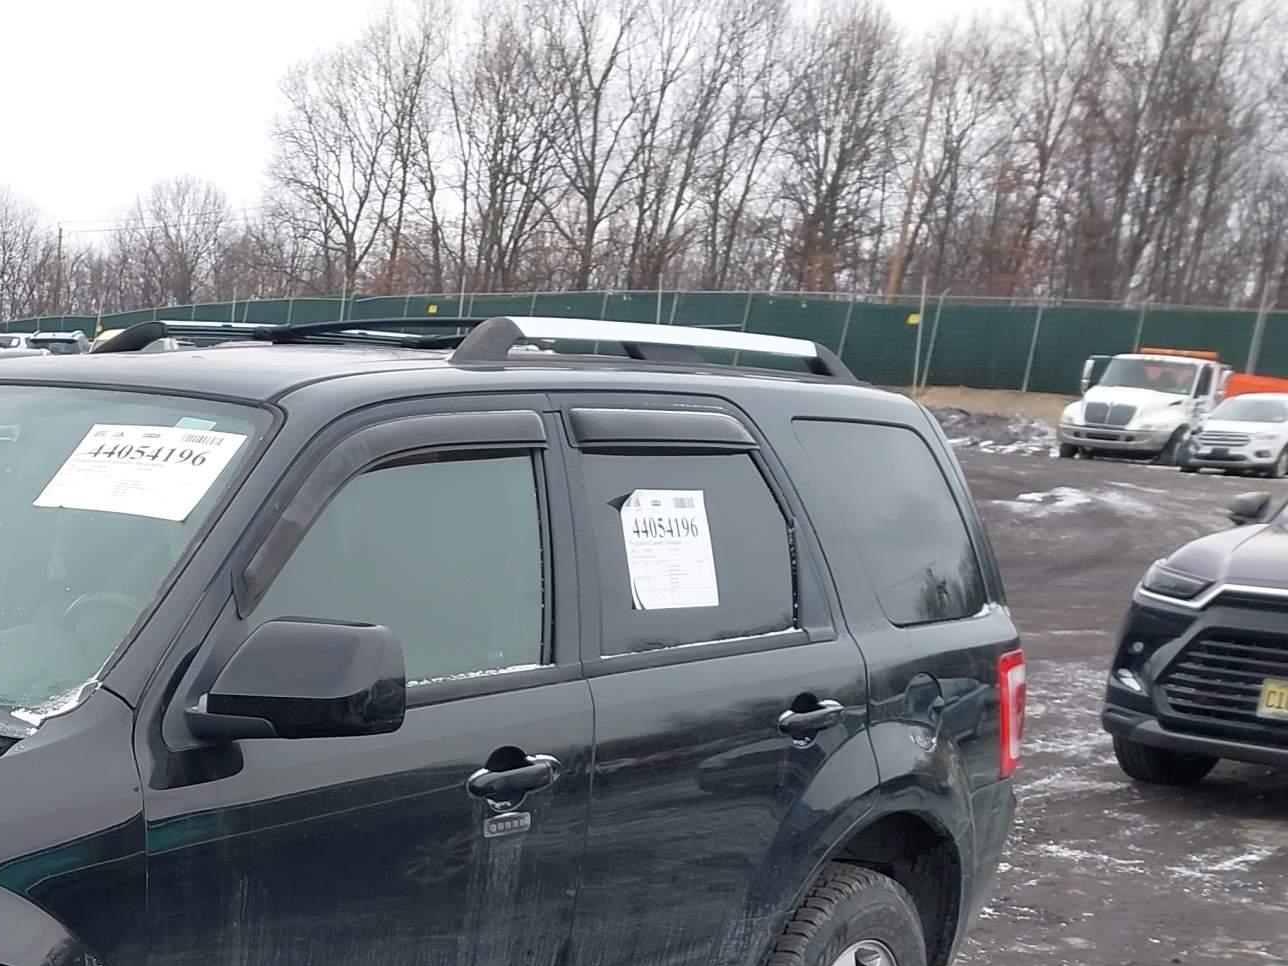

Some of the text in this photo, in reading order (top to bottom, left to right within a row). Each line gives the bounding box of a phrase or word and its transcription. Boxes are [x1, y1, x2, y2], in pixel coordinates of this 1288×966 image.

[86, 443, 208, 466] 44054196
[632, 516, 698, 538] 44054196
[1265, 690, 1288, 710] C1
